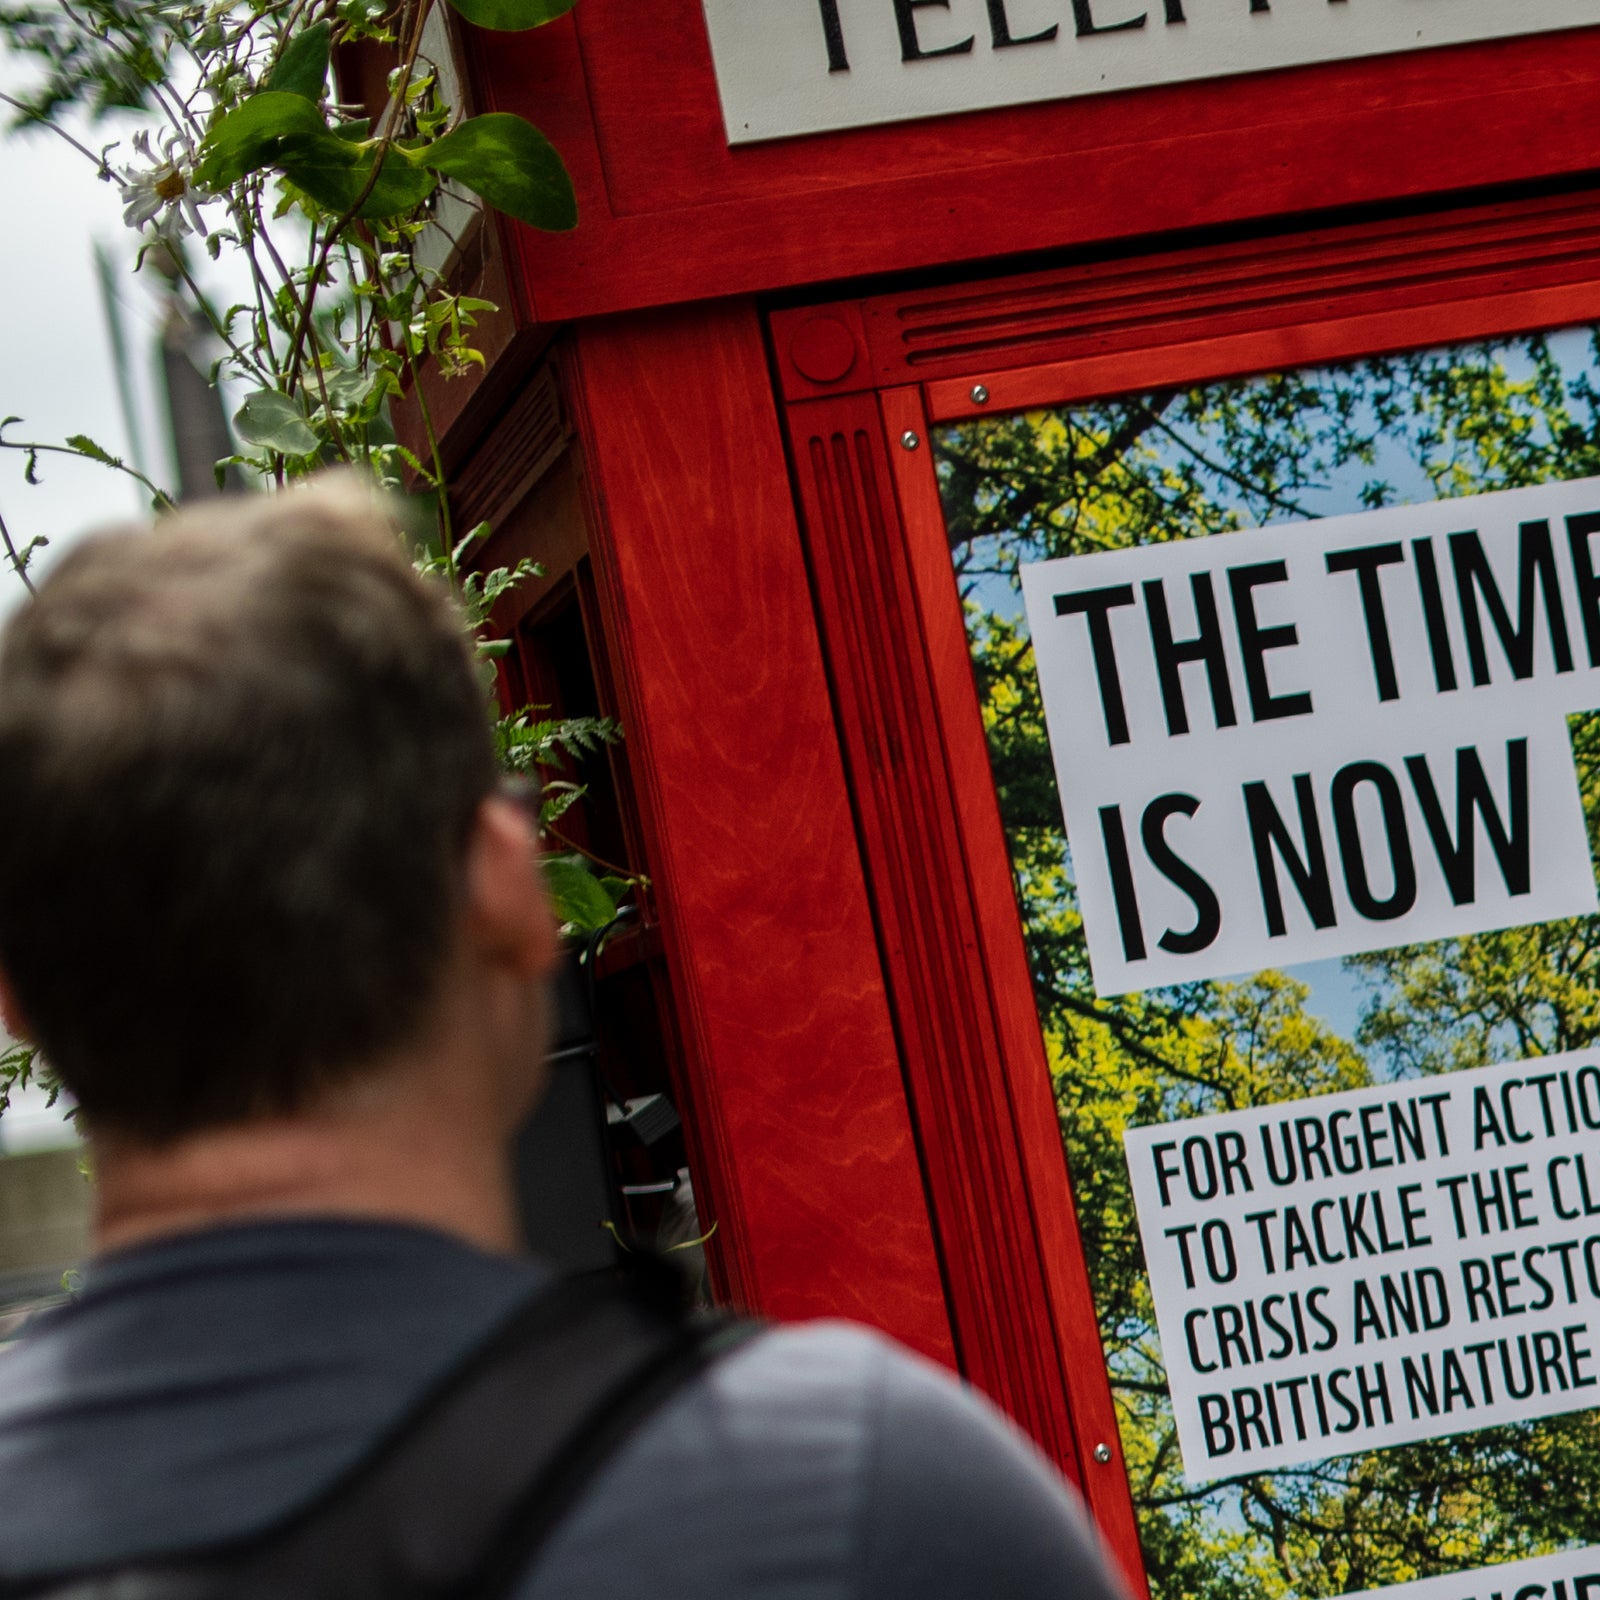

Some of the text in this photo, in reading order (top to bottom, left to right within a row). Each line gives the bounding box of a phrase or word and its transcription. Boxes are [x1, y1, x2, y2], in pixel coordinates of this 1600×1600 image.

[1053, 560, 1313, 747] THE
[1098, 737, 1530, 963] IS NOW
[1151, 1131, 1254, 1206] FOR
[1260, 1092, 1451, 1188] URGENT
[1165, 1219, 1238, 1289] TO
[1245, 1183, 1433, 1275] TACKLE
[1437, 1164, 1539, 1239] THE
[1184, 1286, 1339, 1374] CRISIS
[1354, 1266, 1452, 1344] AND
[1198, 1364, 1394, 1459] BRITISH
